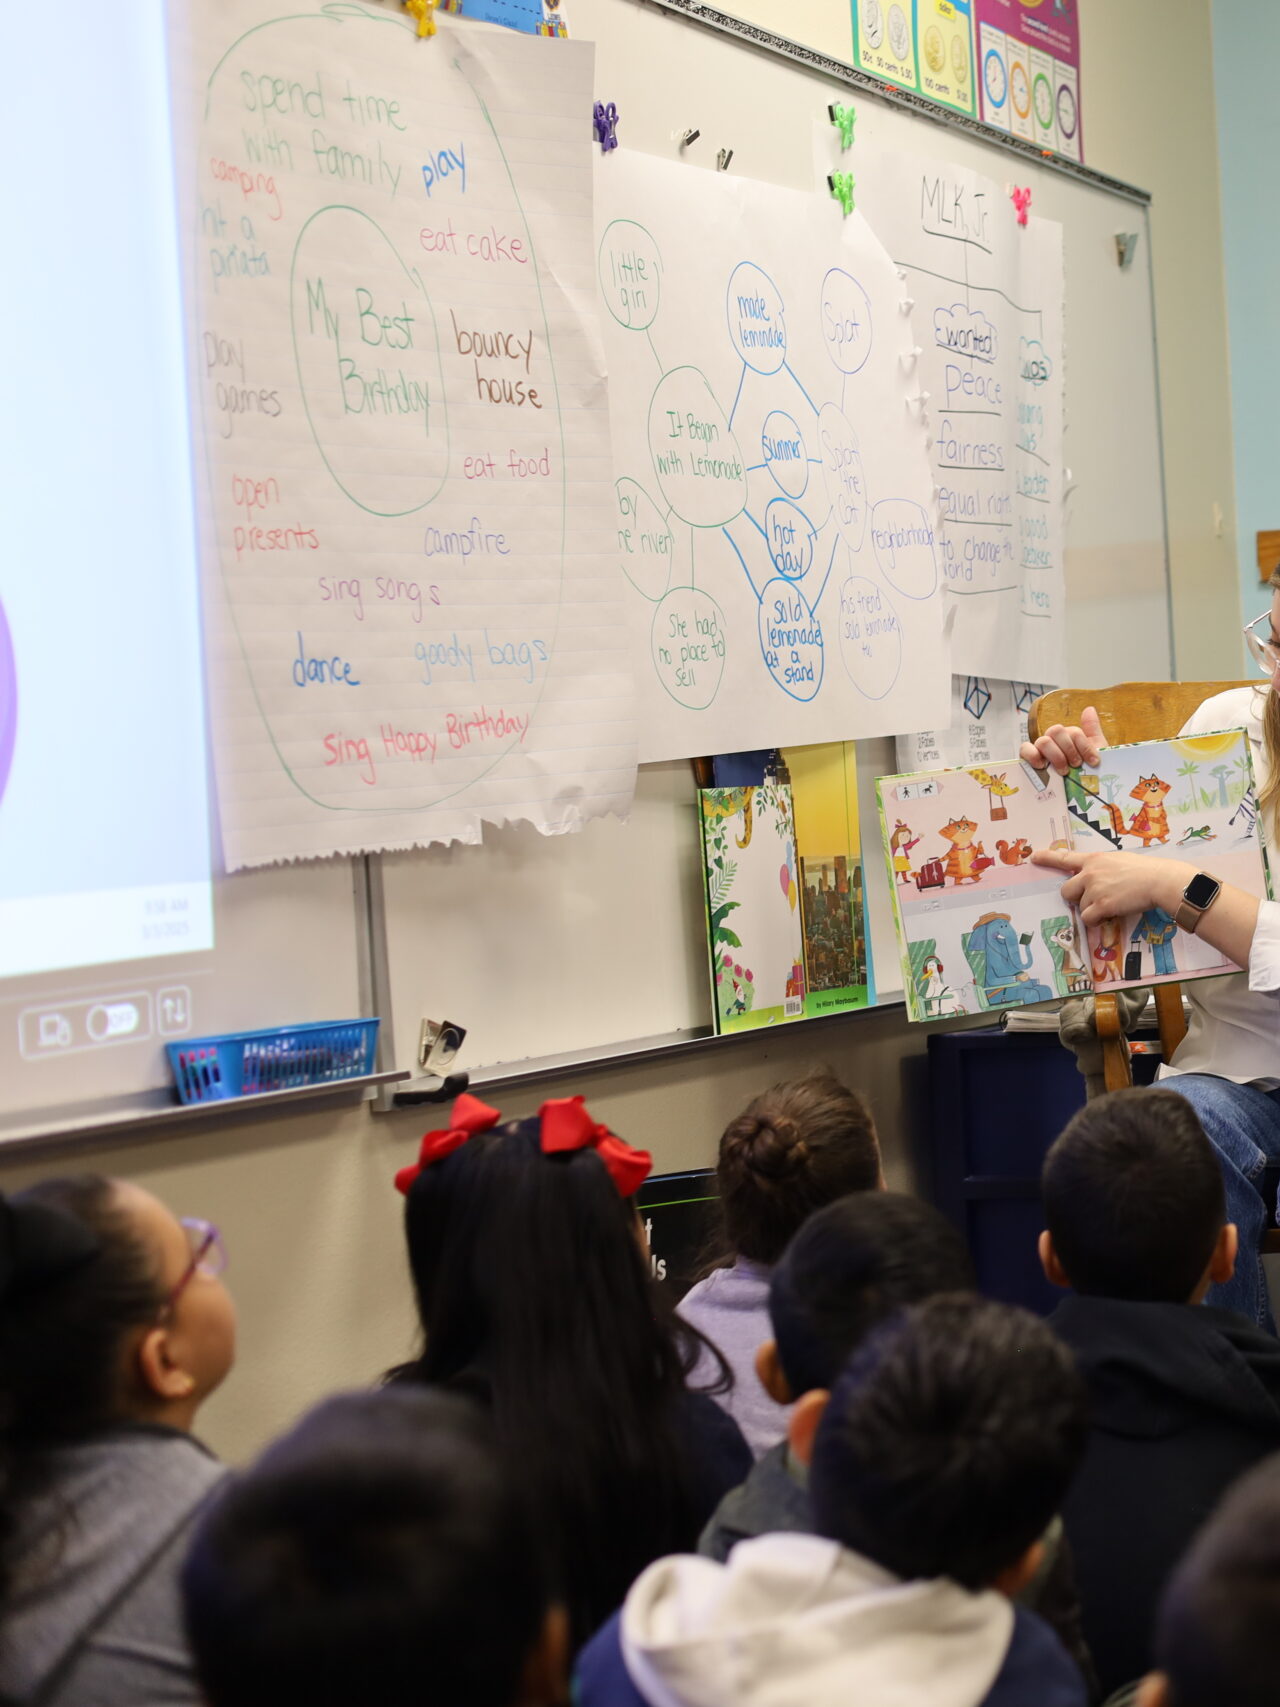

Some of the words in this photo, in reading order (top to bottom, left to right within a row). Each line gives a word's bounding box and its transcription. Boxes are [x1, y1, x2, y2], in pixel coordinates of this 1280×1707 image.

[343, 80, 407, 131] time
[241, 128, 294, 171] with
[311, 128, 402, 196] family
[421, 142, 467, 198] play
[209, 157, 284, 222] camping
[240, 214, 256, 242] a
[419, 218, 459, 258] eat
[466, 226, 529, 265] cake
[305, 276, 345, 345] My
[355, 286, 416, 350] Best
[737, 288, 771, 322] made
[203, 330, 246, 381] play
[449, 308, 533, 374] bouncy
[738, 320, 787, 351] lemonade
[338, 357, 431, 437] Birthday
[475, 358, 543, 410] house
[216, 381, 283, 439] games
[463, 451, 496, 480] eat
[506, 447, 551, 478] food
[656, 449, 684, 477] with
[690, 451, 744, 482] Lemonade
[935, 418, 1004, 468] fairness
[231, 473, 281, 522] open
[616, 486, 638, 529] by
[937, 486, 982, 522] equal
[232, 521, 320, 563] presents
[423, 516, 512, 566] campfire
[772, 513, 797, 546] hot
[938, 530, 955, 562] to
[774, 547, 804, 582] day
[318, 576, 364, 621] sing
[376, 576, 441, 624] songs
[694, 608, 719, 637] had
[658, 645, 673, 665] no
[680, 641, 709, 669] place
[711, 635, 725, 658] to
[766, 616, 824, 648] lemonade
[292, 631, 361, 687] dance
[413, 633, 473, 686] goody
[484, 628, 548, 684] bags
[765, 649, 780, 669] at
[790, 649, 801, 664] a
[784, 660, 815, 686] stand
[380, 723, 438, 765] Happy
[445, 704, 530, 750] Birthday
